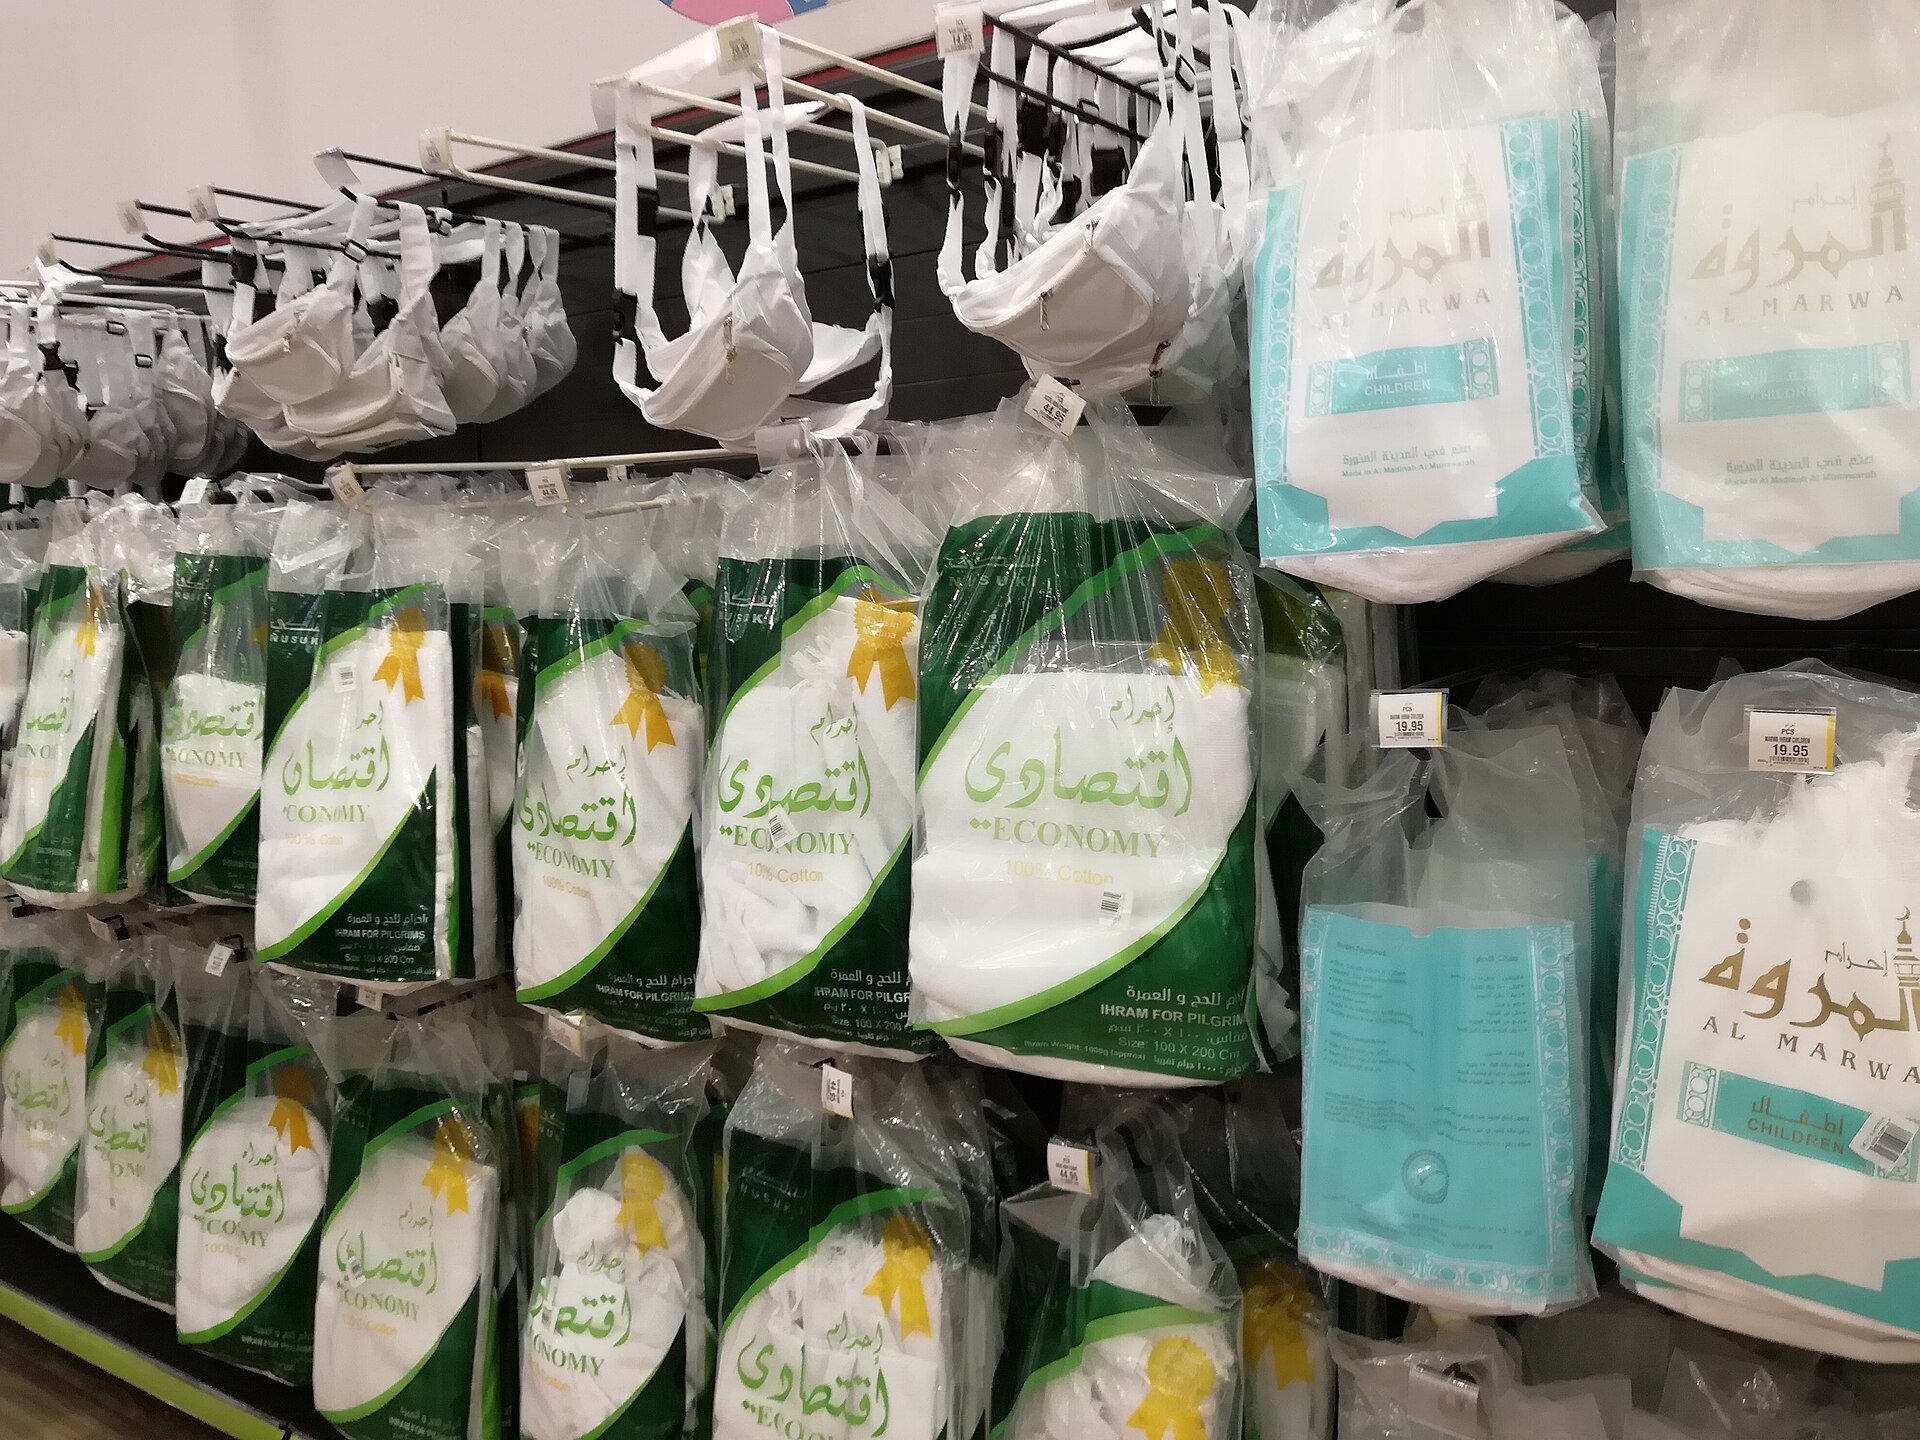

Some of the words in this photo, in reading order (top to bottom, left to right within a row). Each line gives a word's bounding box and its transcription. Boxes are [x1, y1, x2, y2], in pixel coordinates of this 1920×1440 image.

[1687, 203, 1908, 296] المروة
[1312, 218, 1492, 304] المروة
[1320, 313, 1349, 331] AL
[1371, 287, 1491, 319] MARWA
[1696, 307, 1735, 326] AL
[1762, 284, 1904, 317] MARWA
[1364, 378, 1432, 397] CHILDREN
[1726, 459, 1764, 474] المنورة
[1768, 457, 1810, 472] المدينة
[1396, 720, 1424, 732] 19.95
[1772, 744, 1809, 757] 19.95
[992, 816, 1167, 858] ECONOMY
[535, 842, 615, 879] ECONOMY
[777, 867, 824, 883] Cotton
[1005, 859, 1052, 880] 100%
[1058, 865, 1114, 886] Cotton
[361, 929, 379, 939] FOR
[380, 930, 426, 940] PILGRIMS
[1824, 941, 1889, 977] إحرام
[830, 968, 863, 983] العمرة
[876, 971, 902, 988] للحج
[624, 988, 644, 1001] FOR
[850, 989, 874, 1001] FOR
[1126, 985, 1172, 1002] العمرة
[1191, 992, 1221, 1008] للحج
[1100, 1003, 1149, 1020] IHRAM
[1152, 1008, 1184, 1023] FOR
[854, 1017, 873, 1029] 100
[1110, 1050, 1146, 1062] (approx)
[1117, 1037, 1149, 1050] Size:
[1153, 1040, 1176, 1053] 100
[1178, 1043, 1189, 1055] X
[1191, 1046, 1216, 1058] 200
[1218, 1049, 1241, 1061] Cm
[1702, 1015, 1746, 1041] AL
[1776, 1033, 1920, 1085] MARWA
[1746, 1117, 1846, 1156] CHILDREN
